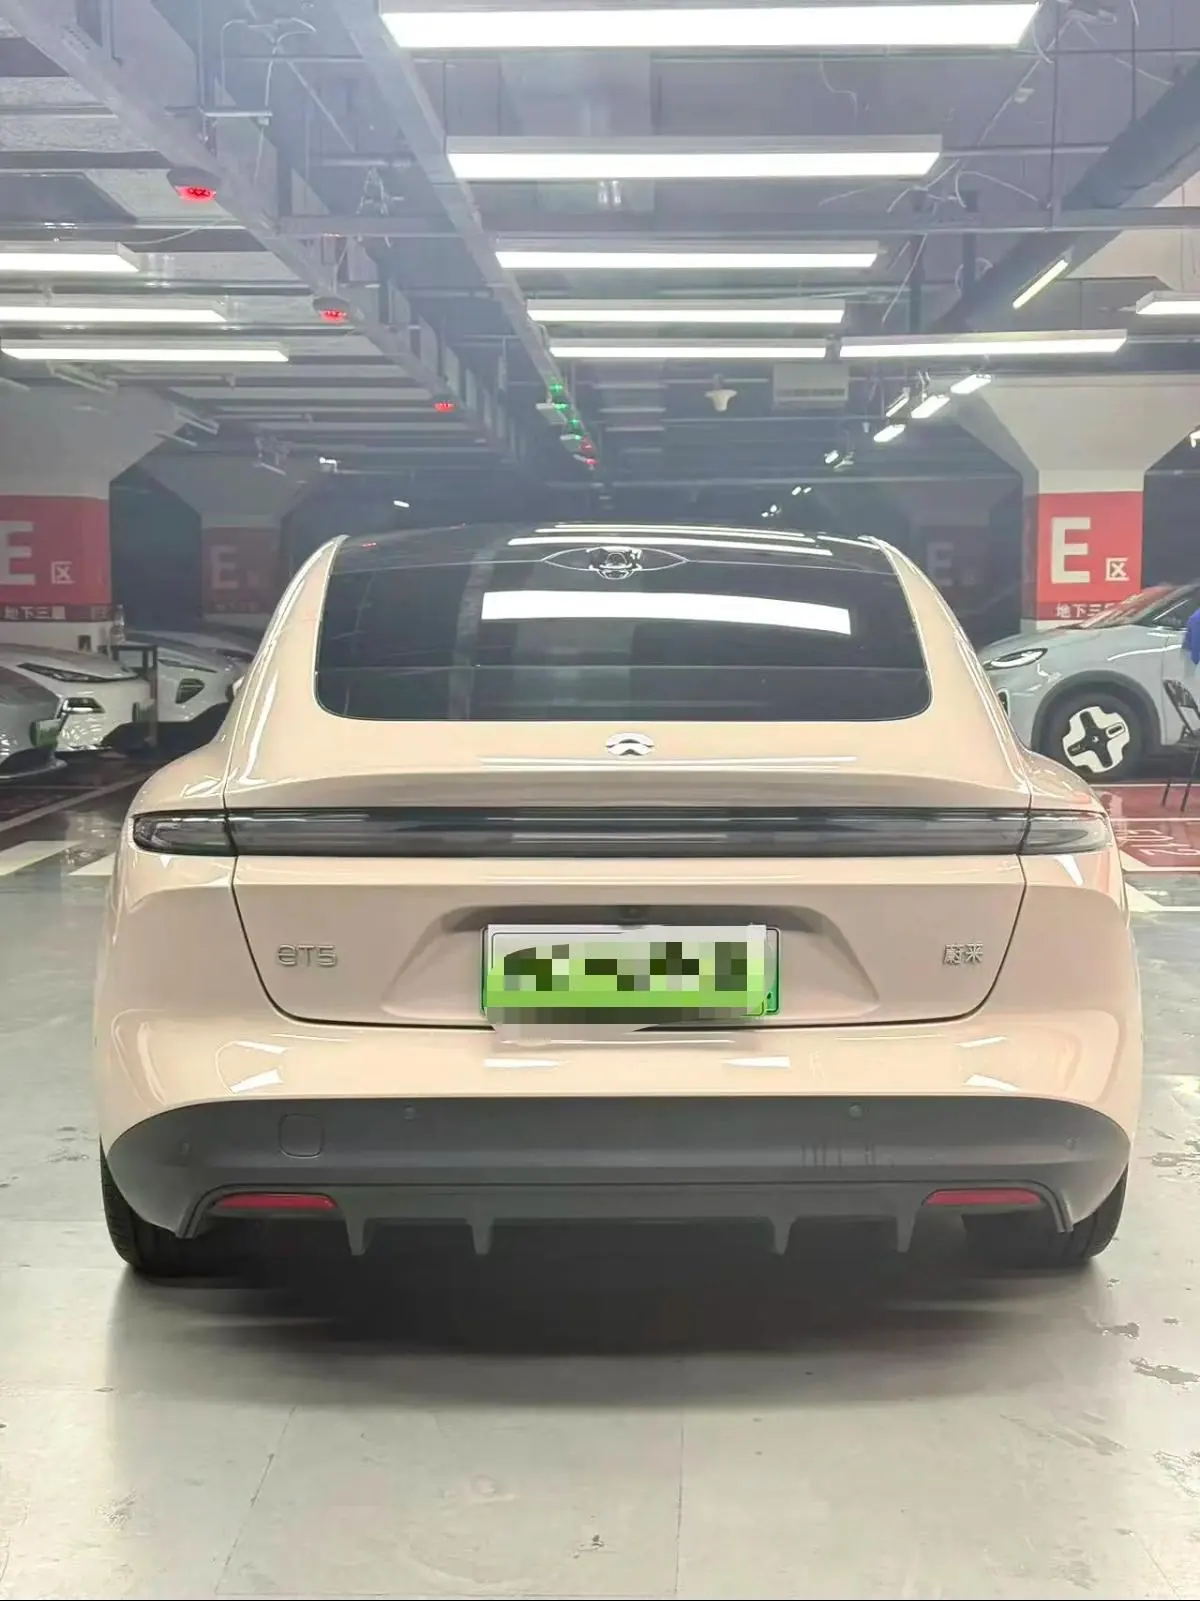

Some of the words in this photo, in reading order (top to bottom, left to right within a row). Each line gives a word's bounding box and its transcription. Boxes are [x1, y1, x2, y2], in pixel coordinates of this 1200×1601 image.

[0, 520, 36, 585] E
[51, 561, 75, 585] 区
[1051, 516, 1091, 584] E
[1105, 557, 1129, 582] 区
[1056, 602, 1117, 619] 地下三
